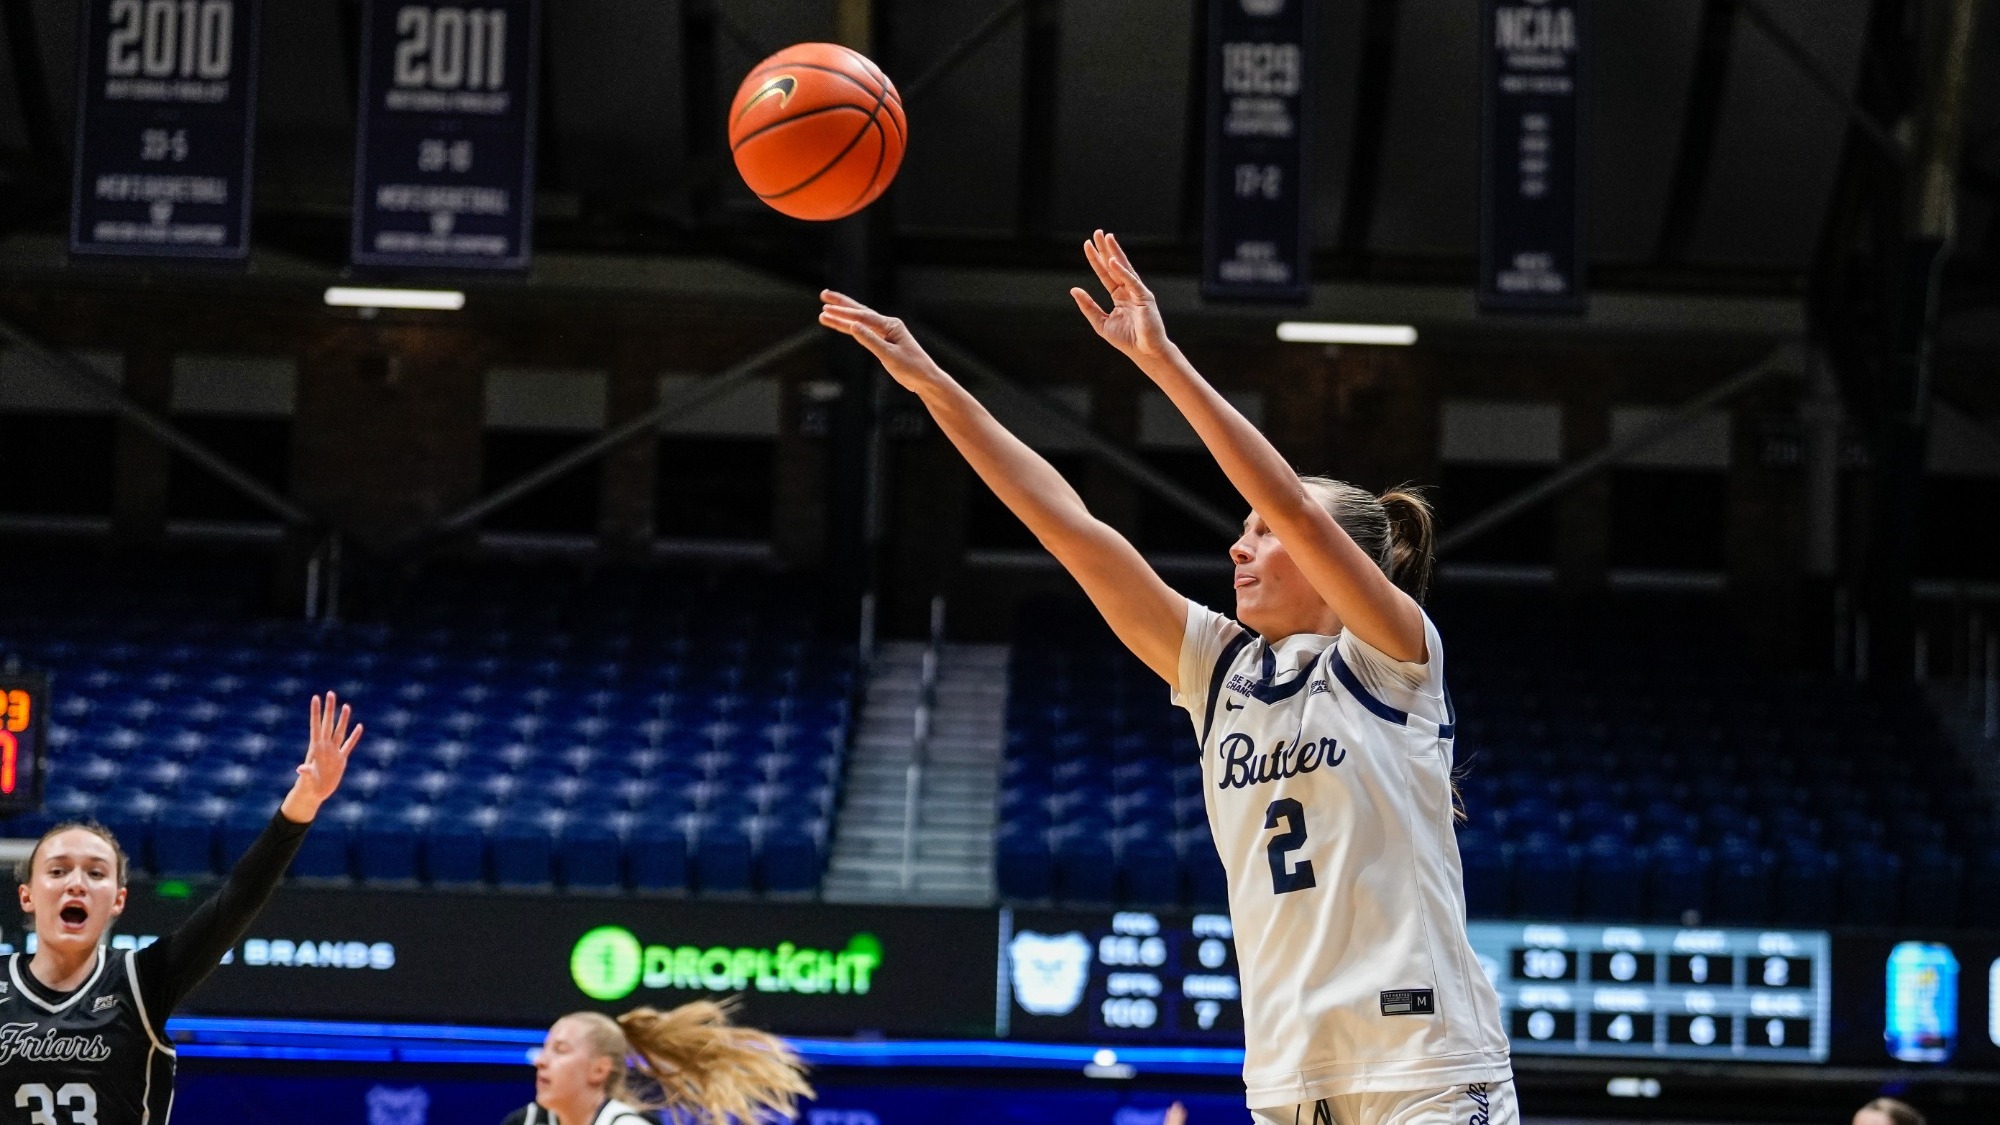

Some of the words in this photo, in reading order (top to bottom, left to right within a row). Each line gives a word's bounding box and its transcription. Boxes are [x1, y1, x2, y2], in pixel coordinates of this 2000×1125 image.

[106, 0, 233, 78] 2010
[394, 5, 507, 90] 2011
[1226, 680, 1252, 698] CHANG
[1232, 674, 1244, 684] BE
[1244, 679, 1256, 691] TH
[1219, 732, 1346, 789] Butler
[1264, 797, 1317, 894] 2
[244, 938, 395, 969] BRANDS
[1101, 998, 1158, 1029] 100
[1194, 1000, 1221, 1030] 7
[1417, 996, 1427, 1007] M
[1607, 1014, 1633, 1041] 4
[0, 1022, 111, 1065] Friars
[15, 1083, 98, 1125] 33
